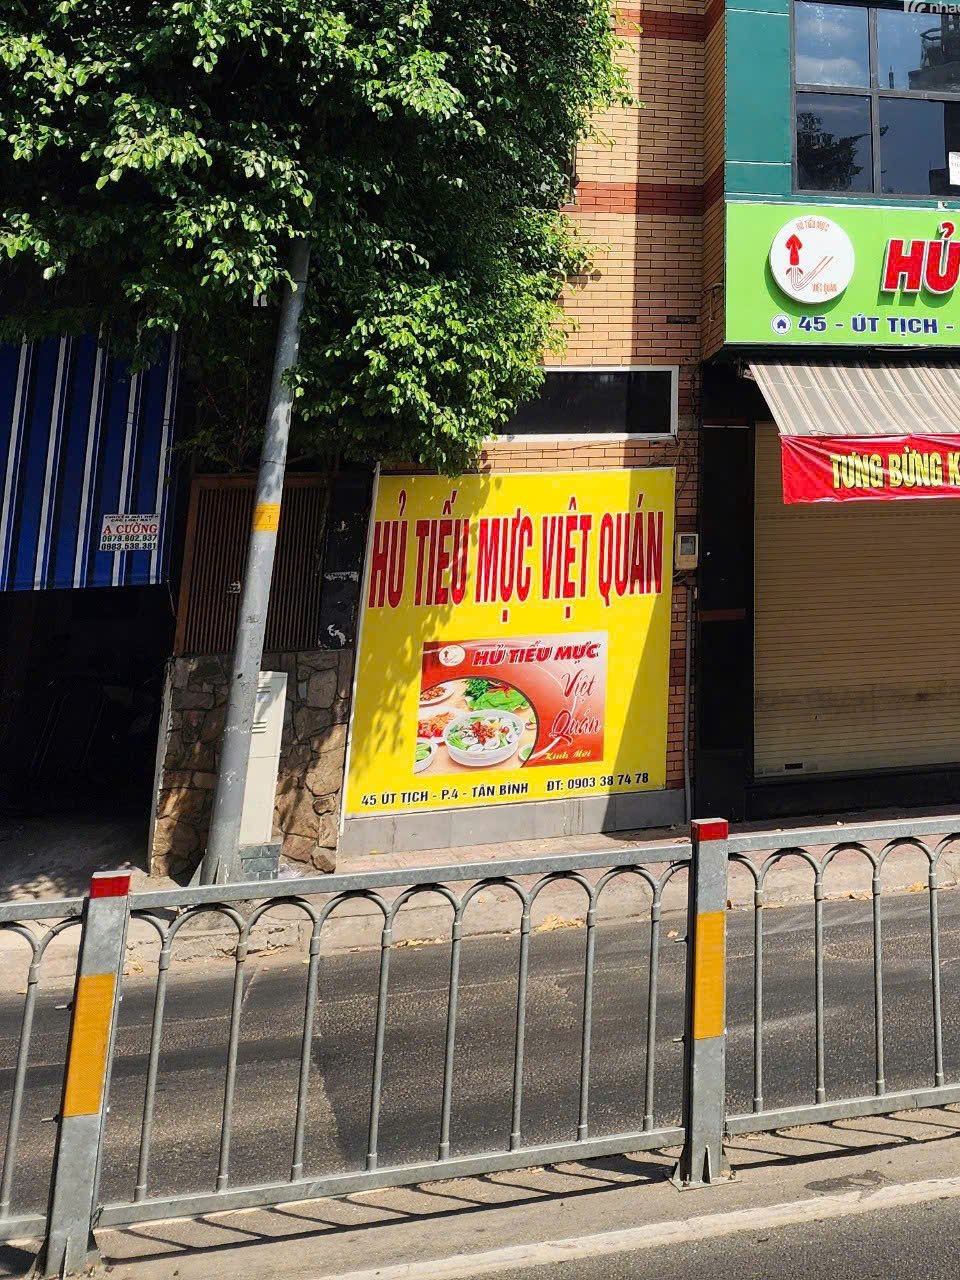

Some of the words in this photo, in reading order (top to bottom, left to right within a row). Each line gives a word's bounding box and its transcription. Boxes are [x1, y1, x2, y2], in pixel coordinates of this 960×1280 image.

[799, 316, 827, 332] 45
[852, 313, 880, 332] ÚT
[887, 317, 938, 336] TỊCH
[830, 451, 884, 489] TƯNG
[888, 446, 943, 488] BỪNG
[368, 489, 408, 609] HỦ
[414, 489, 471, 607] TIẾU
[475, 508, 533, 623] MỰC
[542, 496, 592, 619] VIỆT
[598, 493, 664, 607] QUÁN
[473, 644, 506, 666] HỦ
[509, 640, 553, 664] TIẾU
[554, 640, 601, 664] MỰC
[561, 669, 595, 702] Việt
[549, 708, 600, 746] Quán
[362, 794, 377, 806] 45
[381, 790, 396, 805] ÚT
[400, 791, 429, 806] TỊCH
[441, 789, 459, 800] P.4
[472, 784, 495, 797] TÂN
[499, 781, 529, 796] BÌNH
[546, 780, 563, 791] ĐT:
[567, 777, 596, 789] 0903
[600, 775, 614, 786] 38
[617, 774, 631, 785] 74
[635, 772, 649, 783] 78
